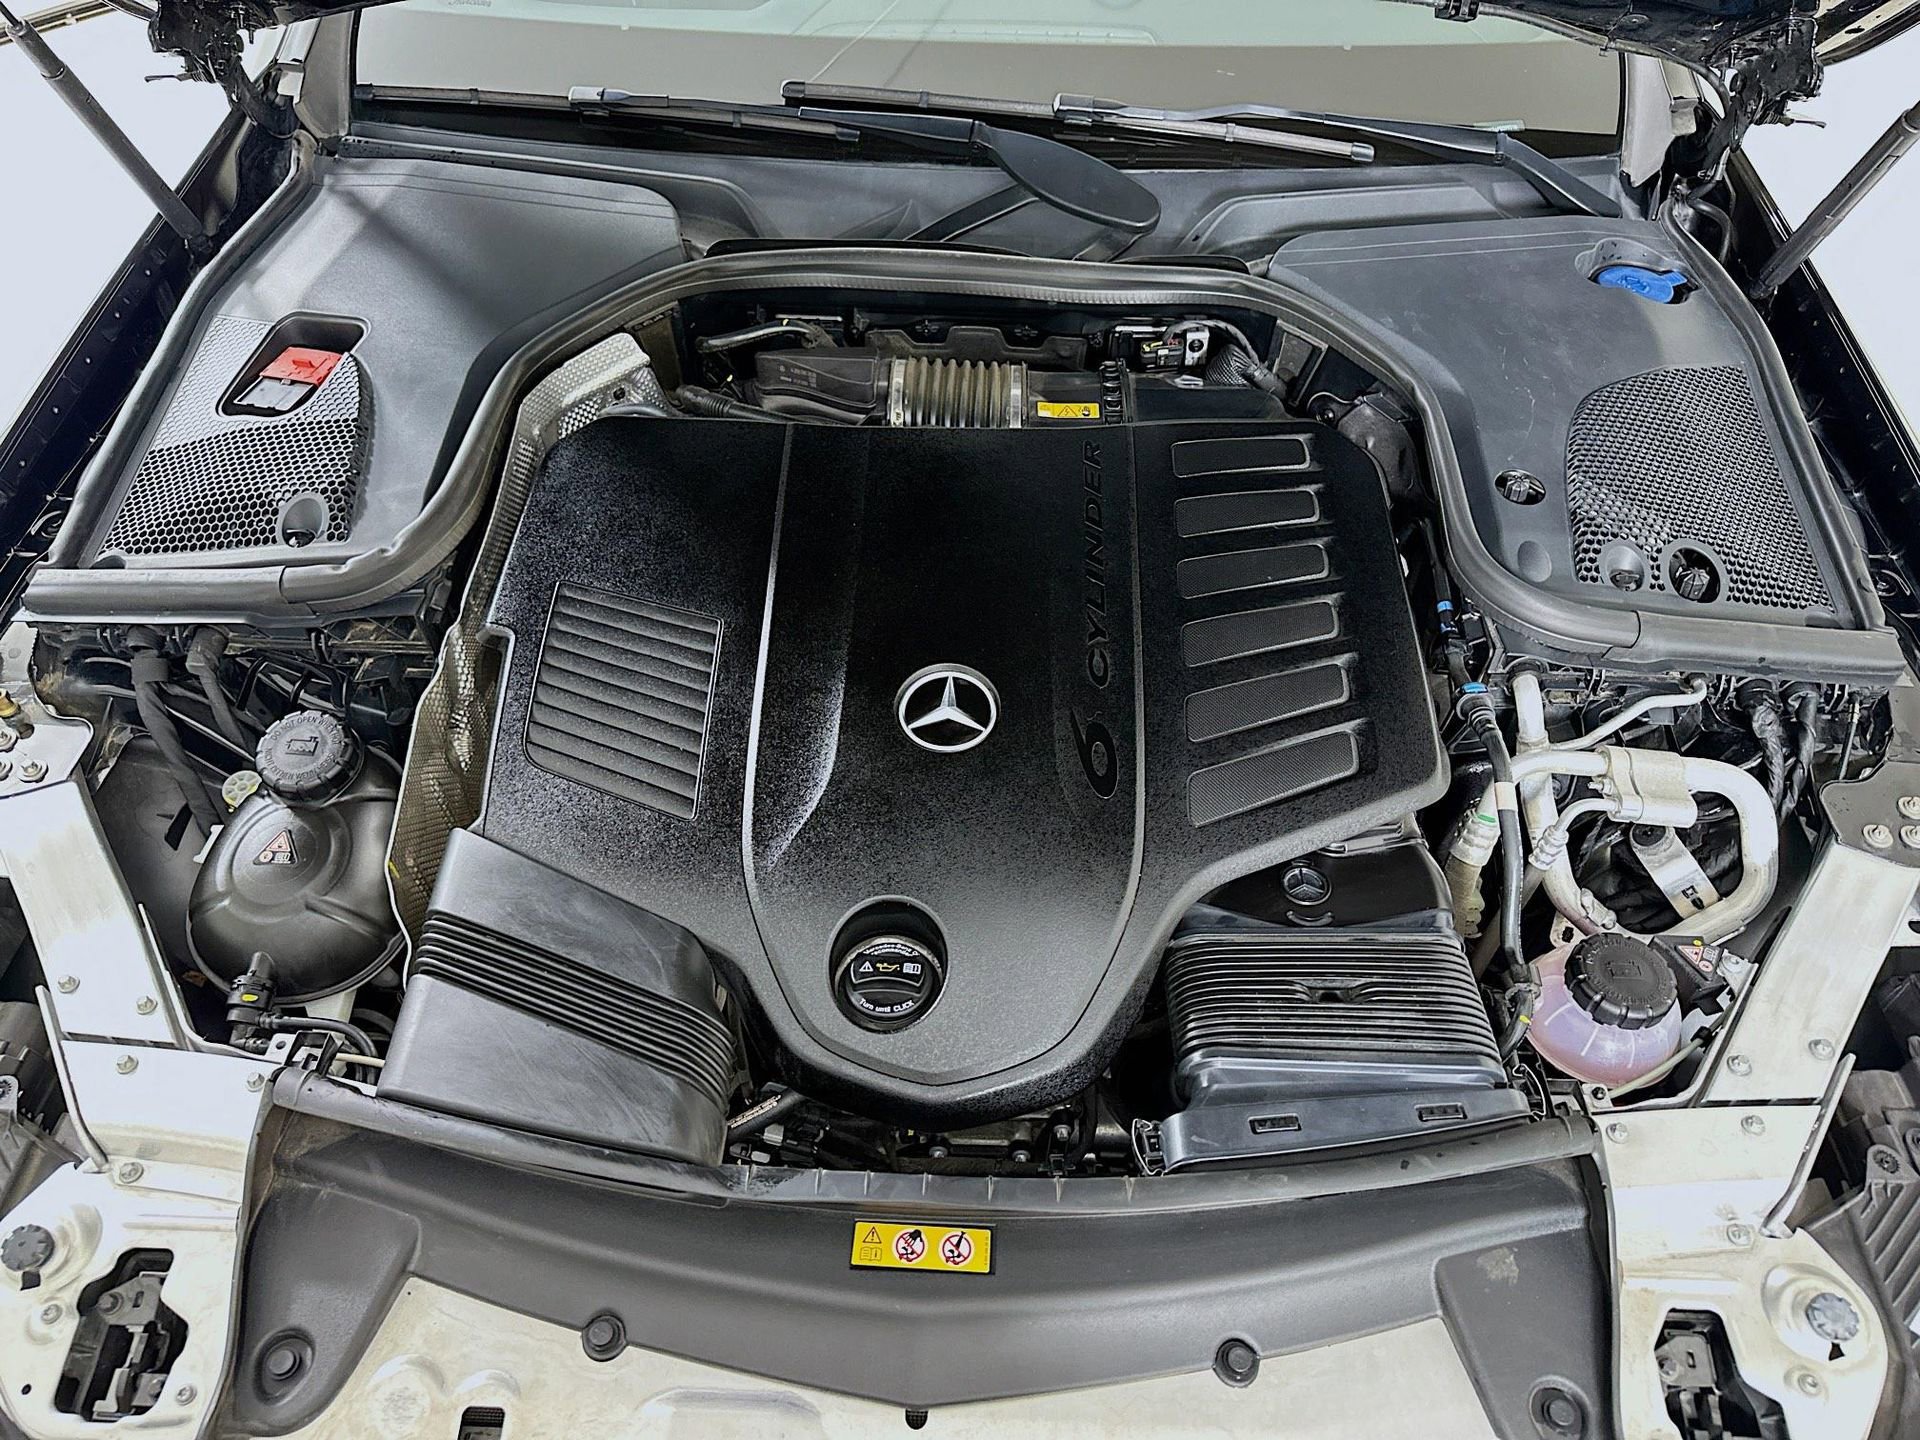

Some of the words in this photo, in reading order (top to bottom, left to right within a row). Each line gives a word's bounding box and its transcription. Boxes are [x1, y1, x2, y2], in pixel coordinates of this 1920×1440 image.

[1082, 439, 1111, 689] CYLINDER
[297, 715, 317, 724] OPEN
[1070, 709, 1118, 800] 6
[859, 998, 874, 1010] Turn
[893, 1000, 915, 1012] CLICK
